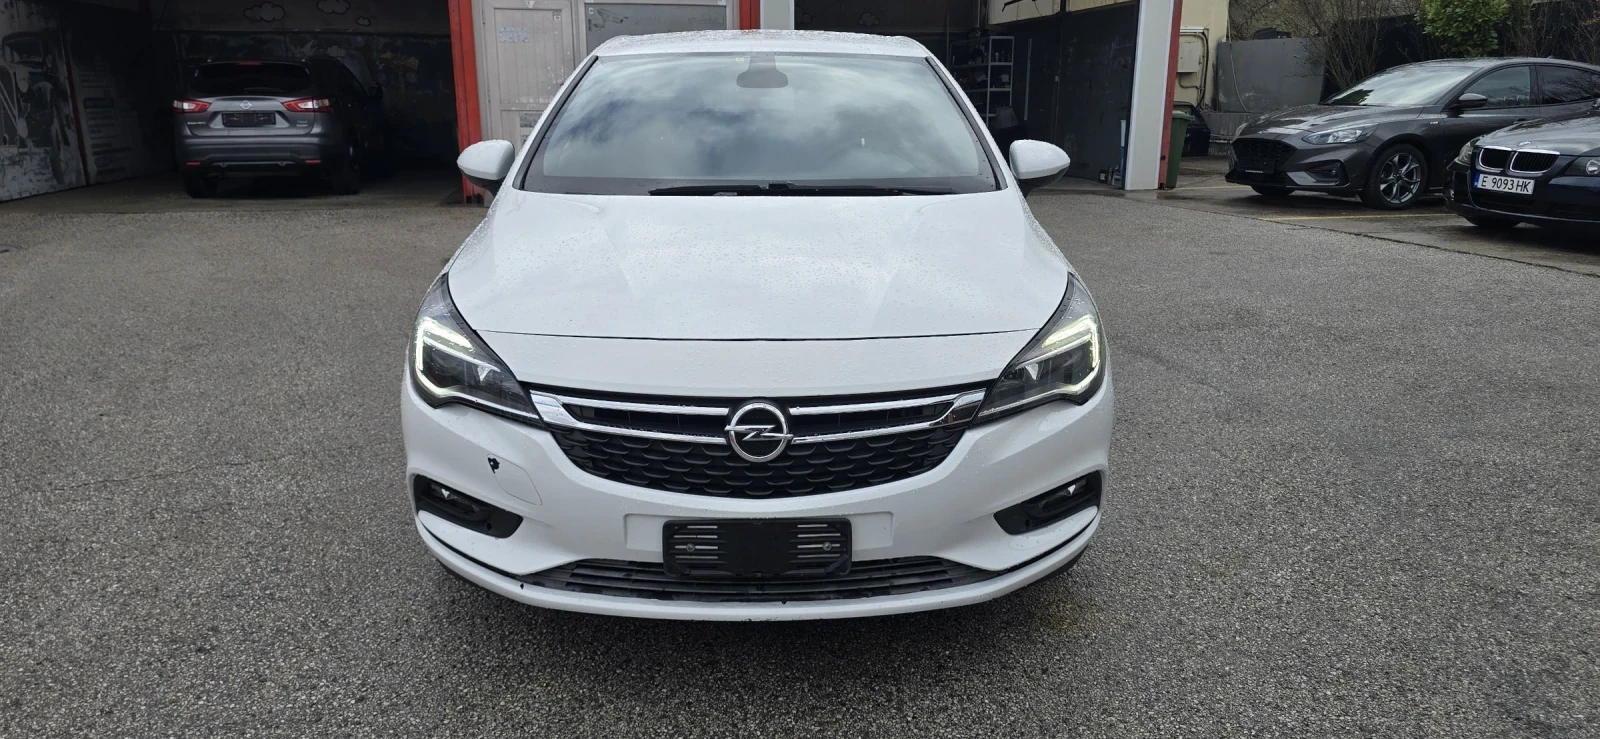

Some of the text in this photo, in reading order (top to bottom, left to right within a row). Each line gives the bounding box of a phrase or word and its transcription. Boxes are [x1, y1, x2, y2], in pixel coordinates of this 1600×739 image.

[1481, 176, 1488, 187] E
[1491, 177, 1515, 190] 9093
[1515, 180, 1531, 192] HK
